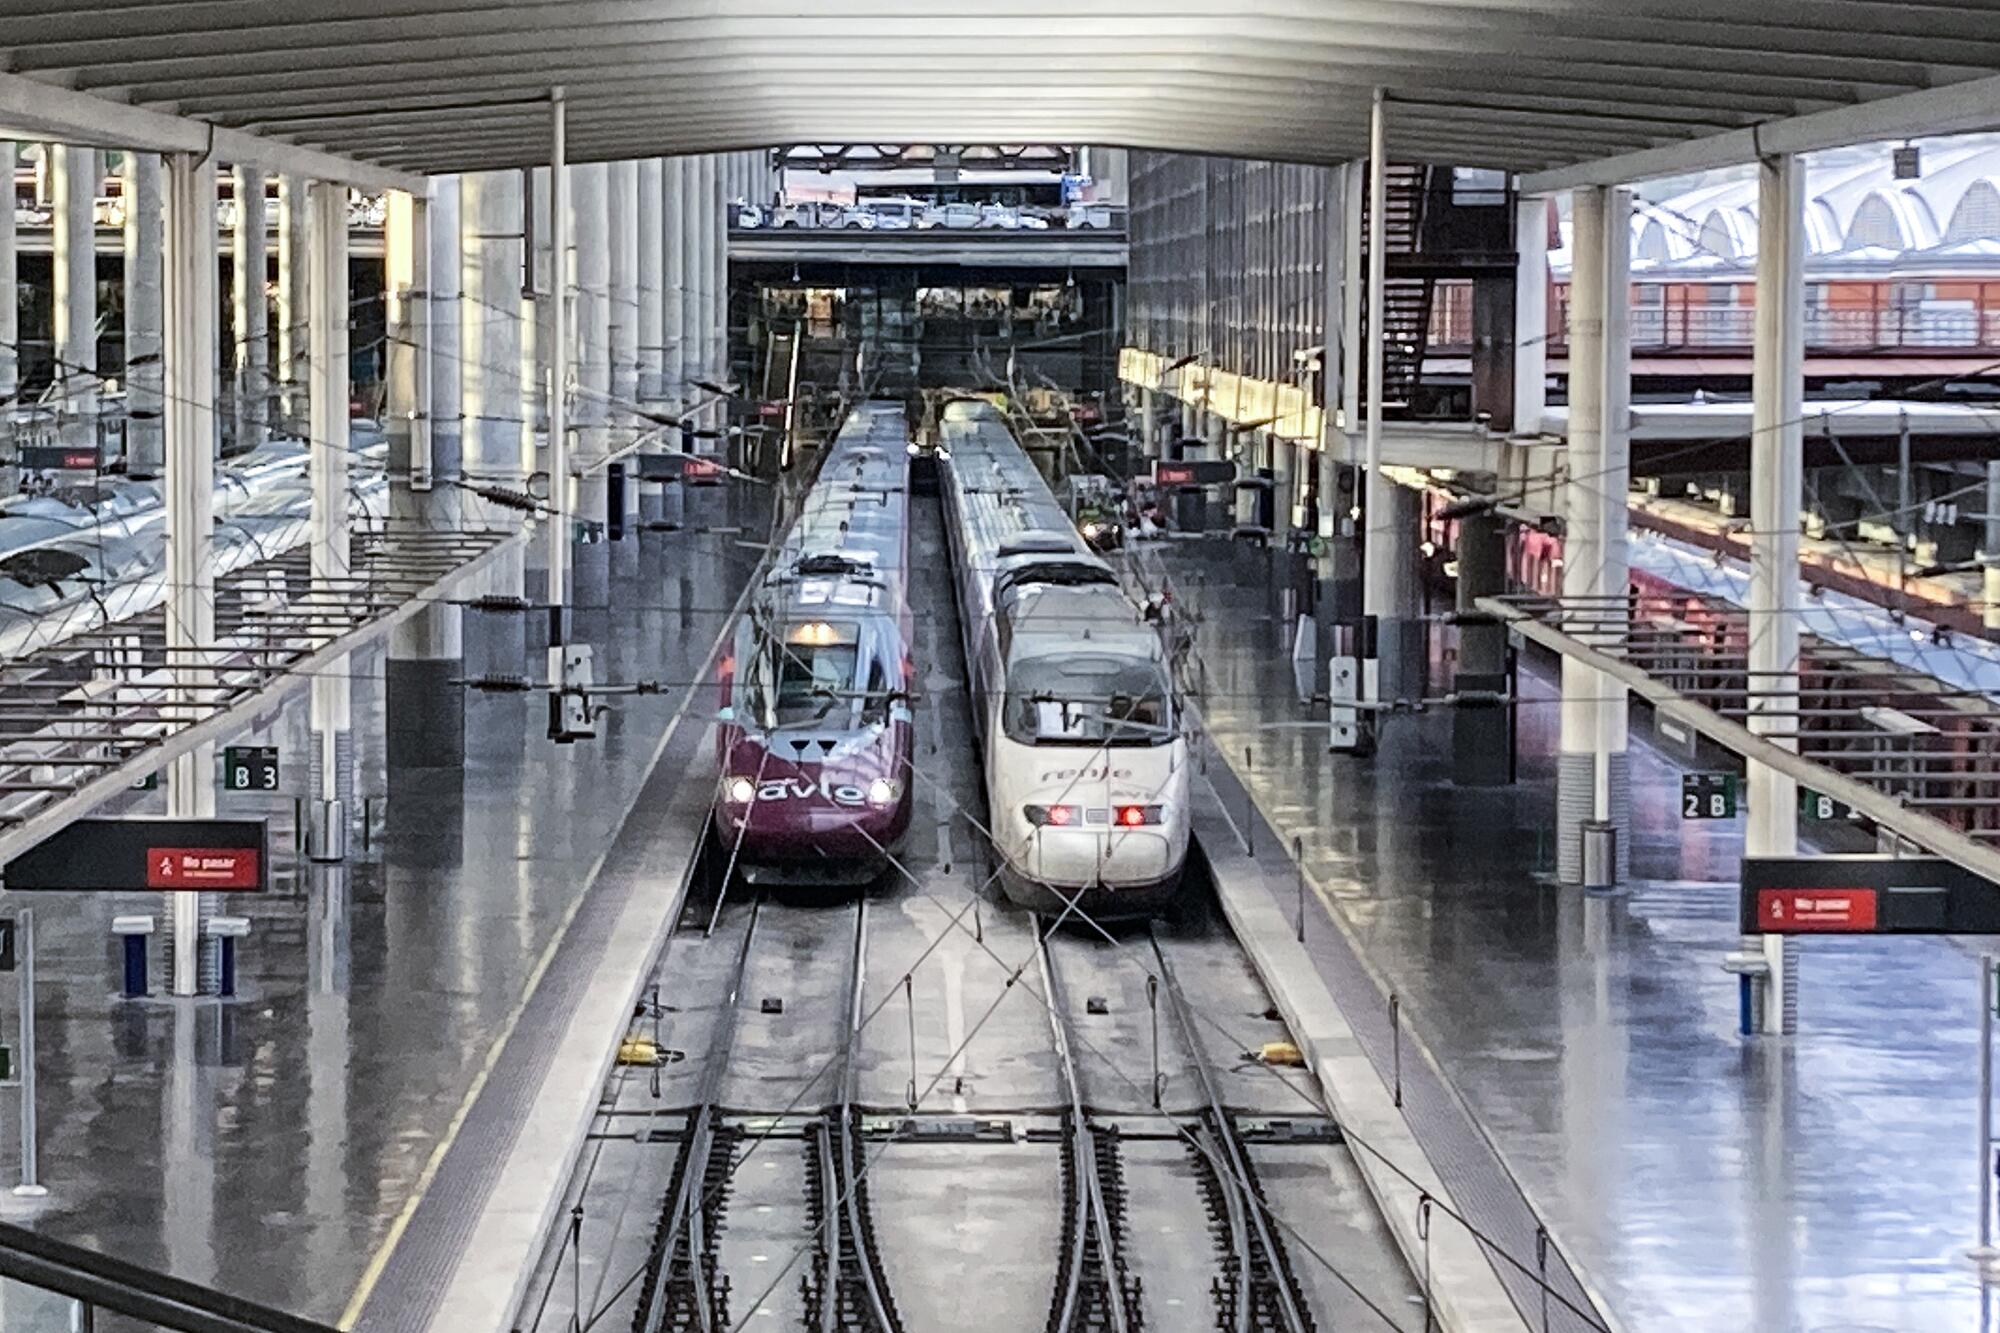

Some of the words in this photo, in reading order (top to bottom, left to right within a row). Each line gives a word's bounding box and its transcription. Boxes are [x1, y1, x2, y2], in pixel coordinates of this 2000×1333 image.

[263, 766, 276, 788] 3
[758, 770, 866, 806] avlo
[1684, 794, 1699, 817] 2
[1710, 793, 1725, 817] B
[1817, 796, 1833, 819] B
